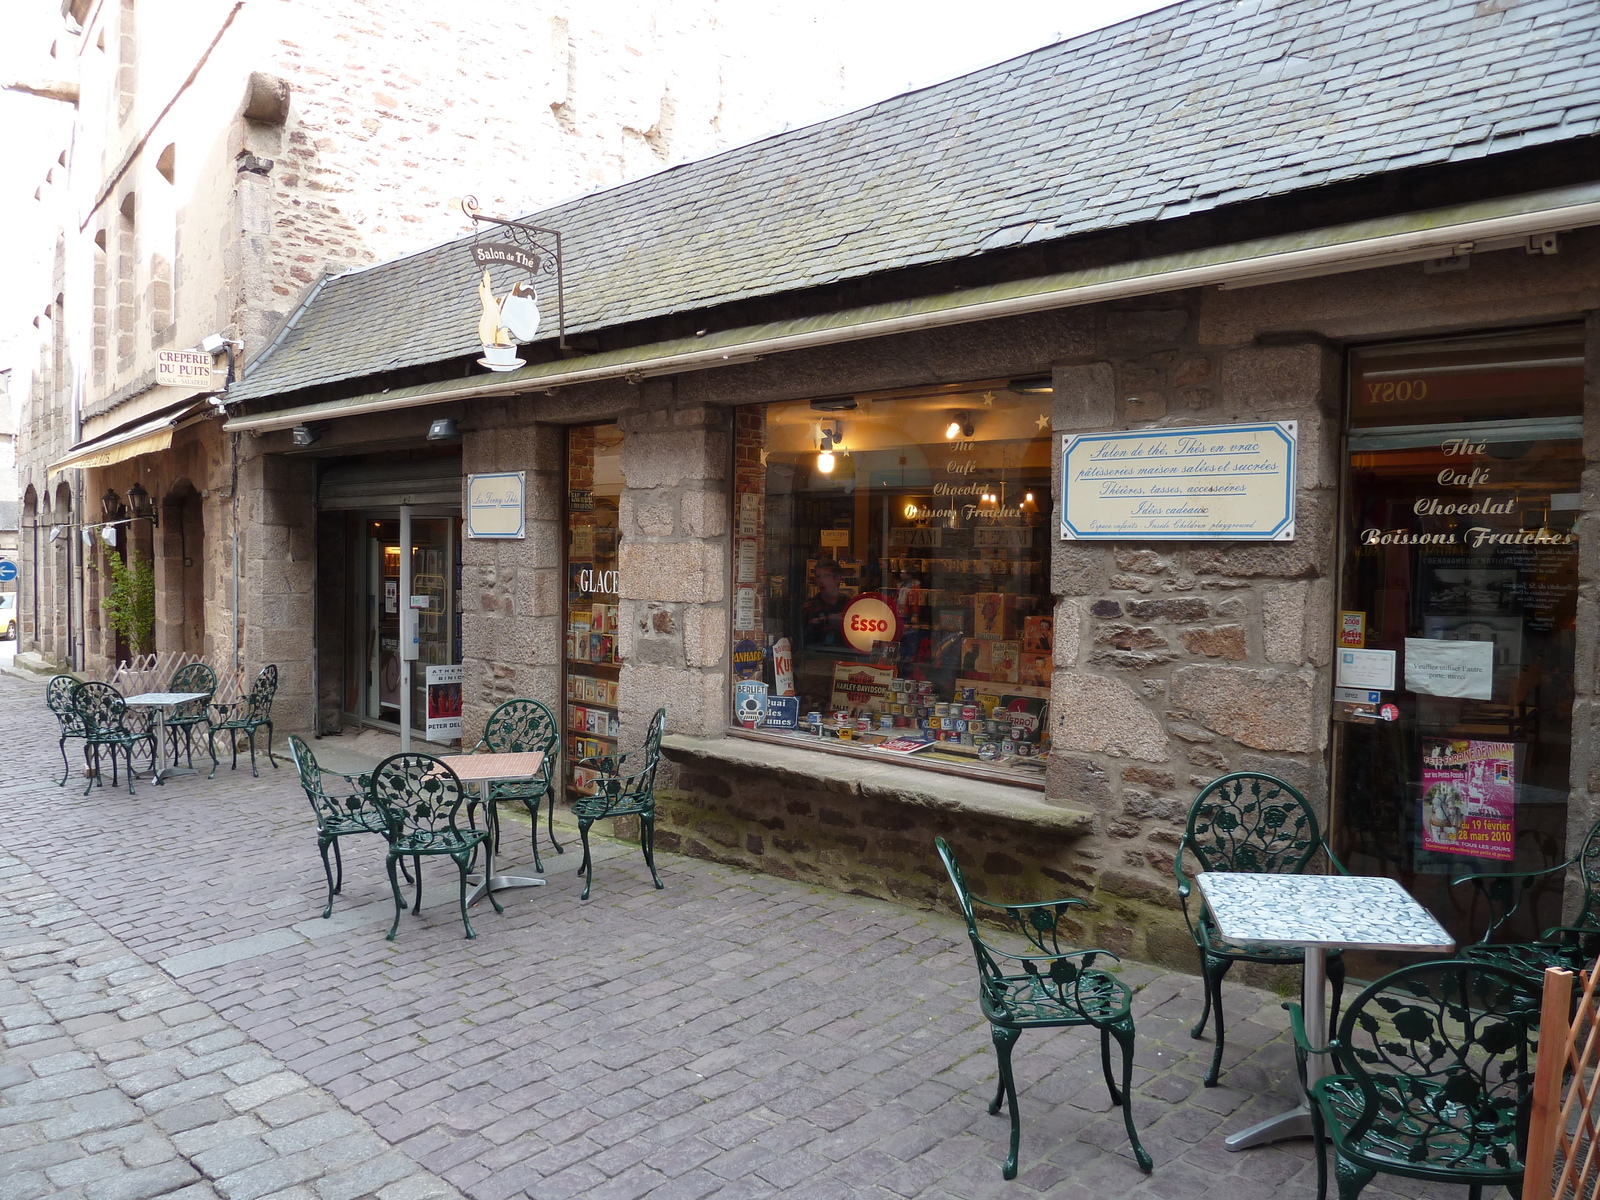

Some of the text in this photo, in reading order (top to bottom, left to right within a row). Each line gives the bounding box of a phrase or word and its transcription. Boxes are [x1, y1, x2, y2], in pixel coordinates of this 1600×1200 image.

[477, 248, 534, 268] Salon de Thé
[159, 352, 210, 365] CREPERIE
[160, 364, 210, 376] DU PUITS
[950, 438, 975, 452] Thé
[1090, 442, 1128, 458] Salon
[1130, 442, 1144, 456] de
[1174, 437, 1206, 454] Thés
[1230, 443, 1260, 452] vrac
[1441, 438, 1487, 456] Thé
[946, 460, 976, 476] Café
[1074, 459, 1279, 482] pâtisseries maison salées et sucrées
[1437, 468, 1490, 488] Café
[933, 482, 990, 496] Chocolat
[1187, 482, 1246, 493] accessoires
[1130, 500, 1210, 515] Idées cadeaux
[1413, 497, 1515, 516] Chocolat
[1090, 520, 1111, 532] Espace
[1113, 520, 1138, 532] enfants
[1174, 518, 1206, 529] Children
[1209, 520, 1257, 532] playground
[1360, 526, 1575, 548] Boissons Fraiches
[1344, 618, 1360, 626] 2008
[1440, 663, 1461, 672] utiliser
[738, 684, 766, 694] BERLIET
[1006, 714, 1036, 728] TERROT
[1444, 748, 1474, 765] FORAINE
[1476, 745, 1486, 759] DE
[1462, 820, 1510, 830] du 19 février
[1458, 831, 1468, 840] 28
[1470, 833, 1489, 841] mars
[1491, 832, 1511, 842] 2010
